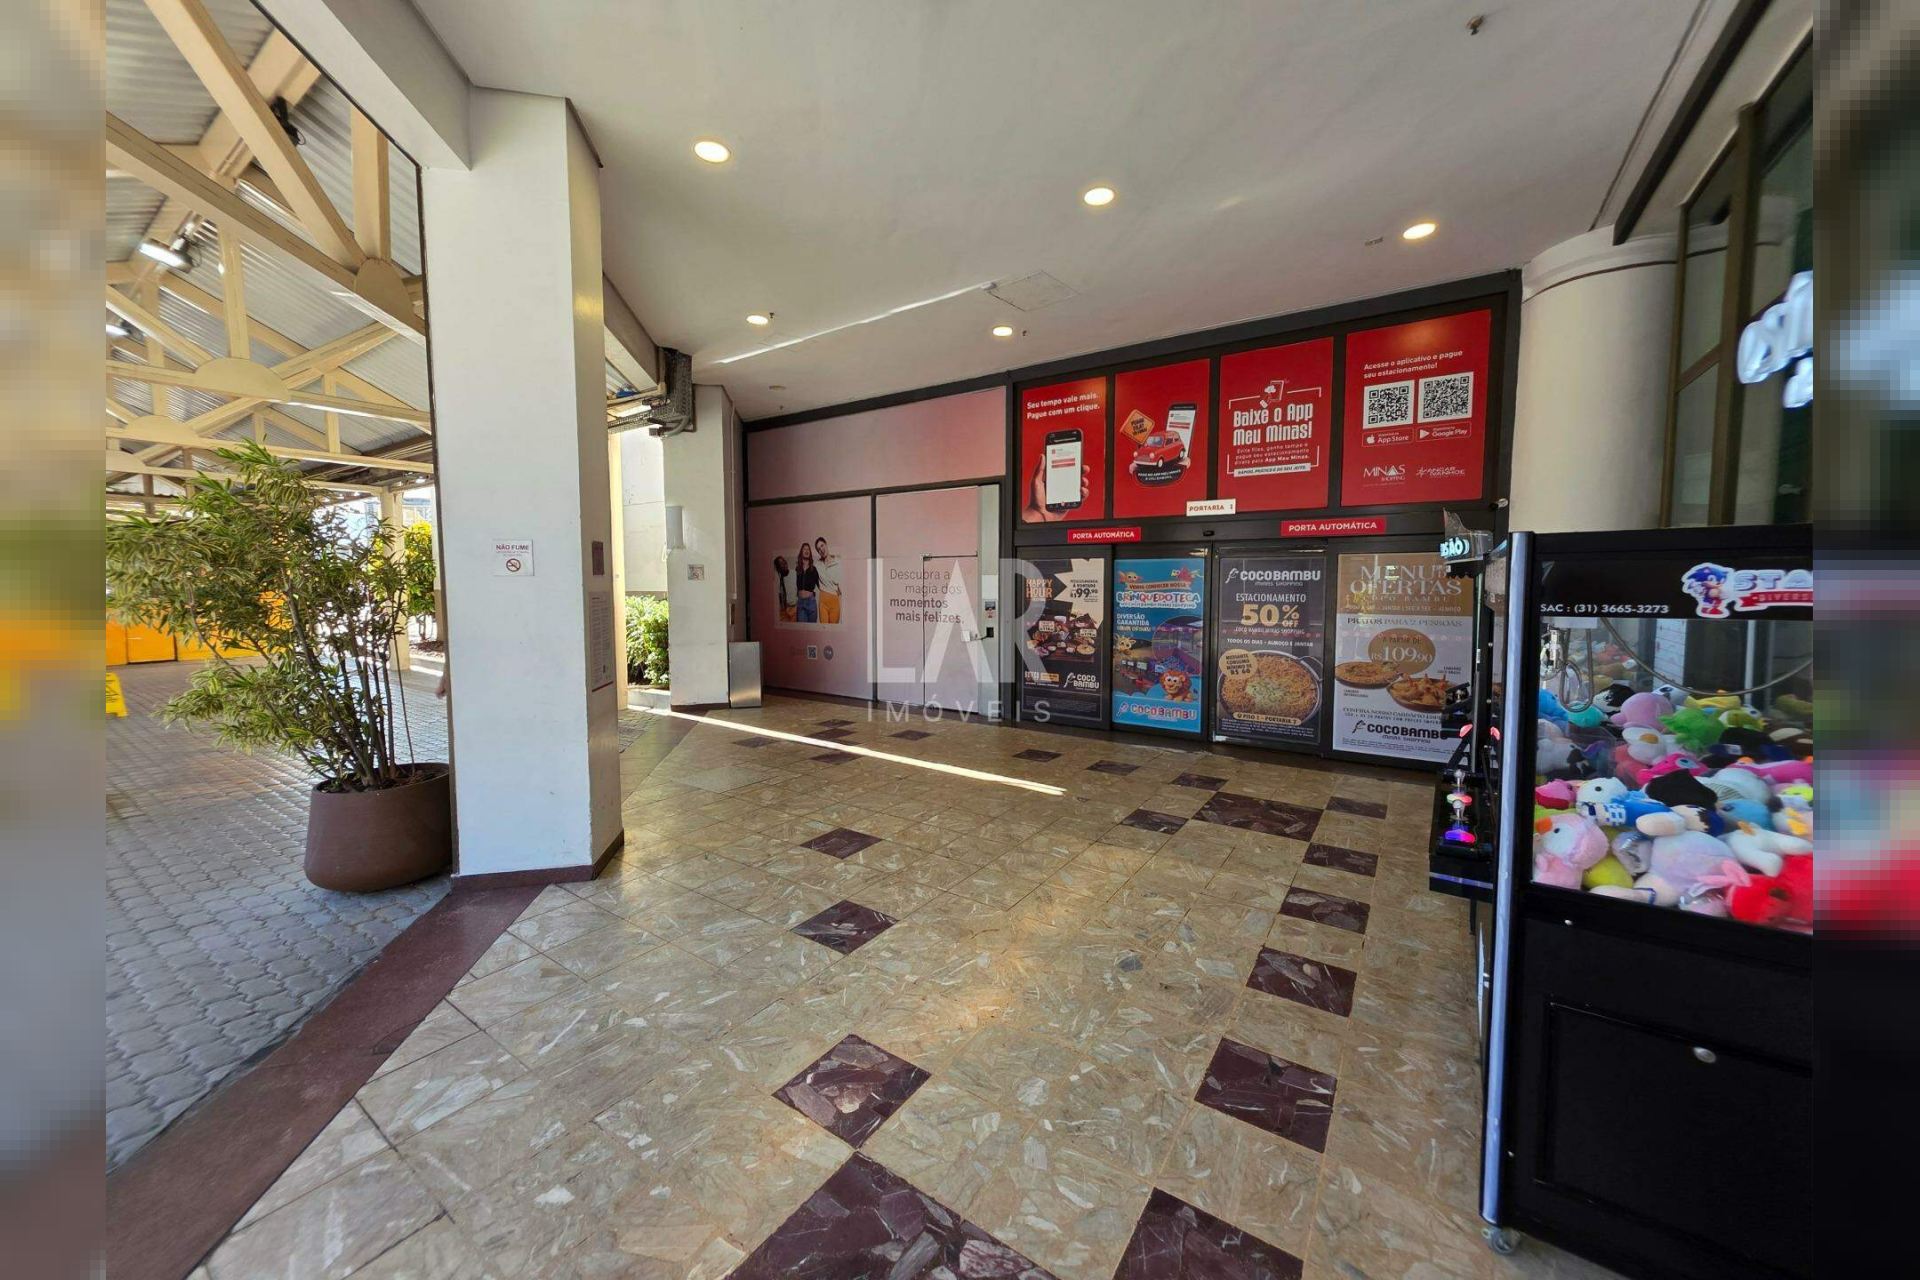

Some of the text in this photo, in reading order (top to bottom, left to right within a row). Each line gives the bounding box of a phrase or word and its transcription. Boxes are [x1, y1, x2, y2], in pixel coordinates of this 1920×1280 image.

[1364, 363, 1389, 371] Acesse
[1396, 355, 1432, 366] aplicativo
[1439, 350, 1463, 360] pague
[1378, 362, 1438, 377] estacionamento!
[1041, 399, 1062, 407] tempo
[1062, 395, 1079, 404] vale
[1079, 391, 1099, 401] mais.
[1027, 403, 1101, 419] Pague com um clique.
[1233, 402, 1314, 428] Baixe o App
[1233, 421, 1313, 446] Meu Minas!
[1432, 430, 1454, 438] Google
[1455, 428, 1468, 436] Play
[1378, 436, 1392, 444] App
[1264, 448, 1310, 457] estacionamento
[1364, 464, 1406, 478] MINAS
[1289, 521, 1377, 532] PORTA AUTOMÁTICA
[1094, 530, 1135, 539] AUTOMÁTICA
[890, 569, 950, 580] Descubra a
[1361, 565, 1434, 580] MENU
[905, 581, 963, 597] magia dos
[1026, 579, 1053, 588] HAPPY
[1350, 580, 1462, 595] OFERTAS
[1026, 587, 1053, 598] HOUR
[1117, 591, 1200, 603] BRINQUEDOTECA
[1236, 593, 1306, 602] ESTACIONAMENTO
[890, 597, 949, 608] momentos
[1540, 604, 1564, 612] SAC
[1574, 604, 1598, 613] (31)
[1601, 604, 1669, 614] 3665-3273
[895, 611, 965, 624] mais felizes.
[1419, 619, 1462, 627] PESSOAS
[1077, 674, 1096, 682] COCO
[1073, 681, 1100, 689] BAMBU
[1265, 715, 1291, 724] PORTARIA
[1392, 711, 1425, 719] CARDÁPIO
